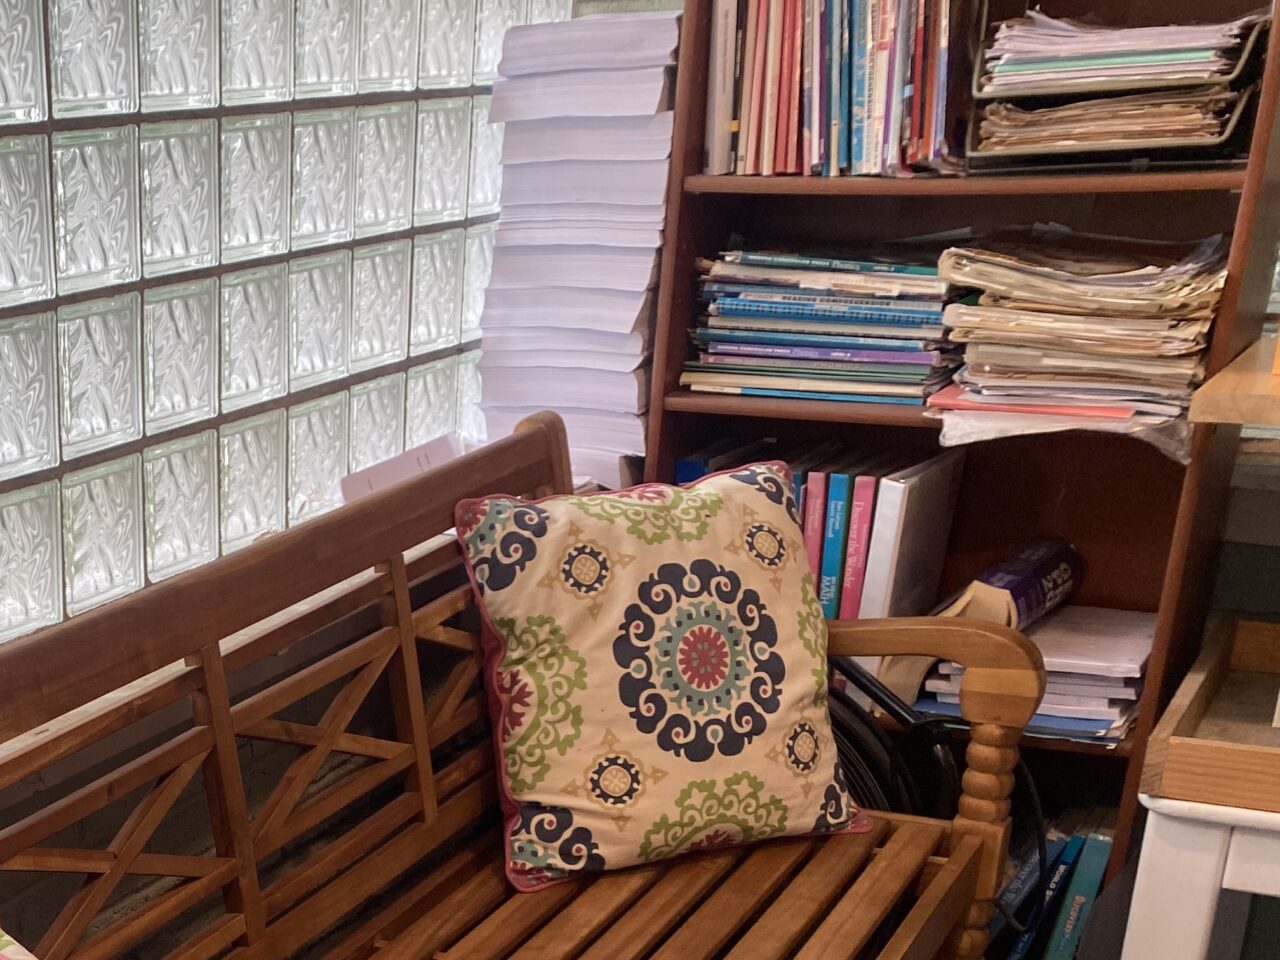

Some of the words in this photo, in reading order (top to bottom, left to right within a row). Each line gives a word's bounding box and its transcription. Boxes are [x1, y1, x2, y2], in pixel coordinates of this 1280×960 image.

[850, 501, 864, 538] Discover
[848, 541, 859, 554] the
[845, 556, 856, 588] Wonder
[821, 575, 831, 604] MATH
